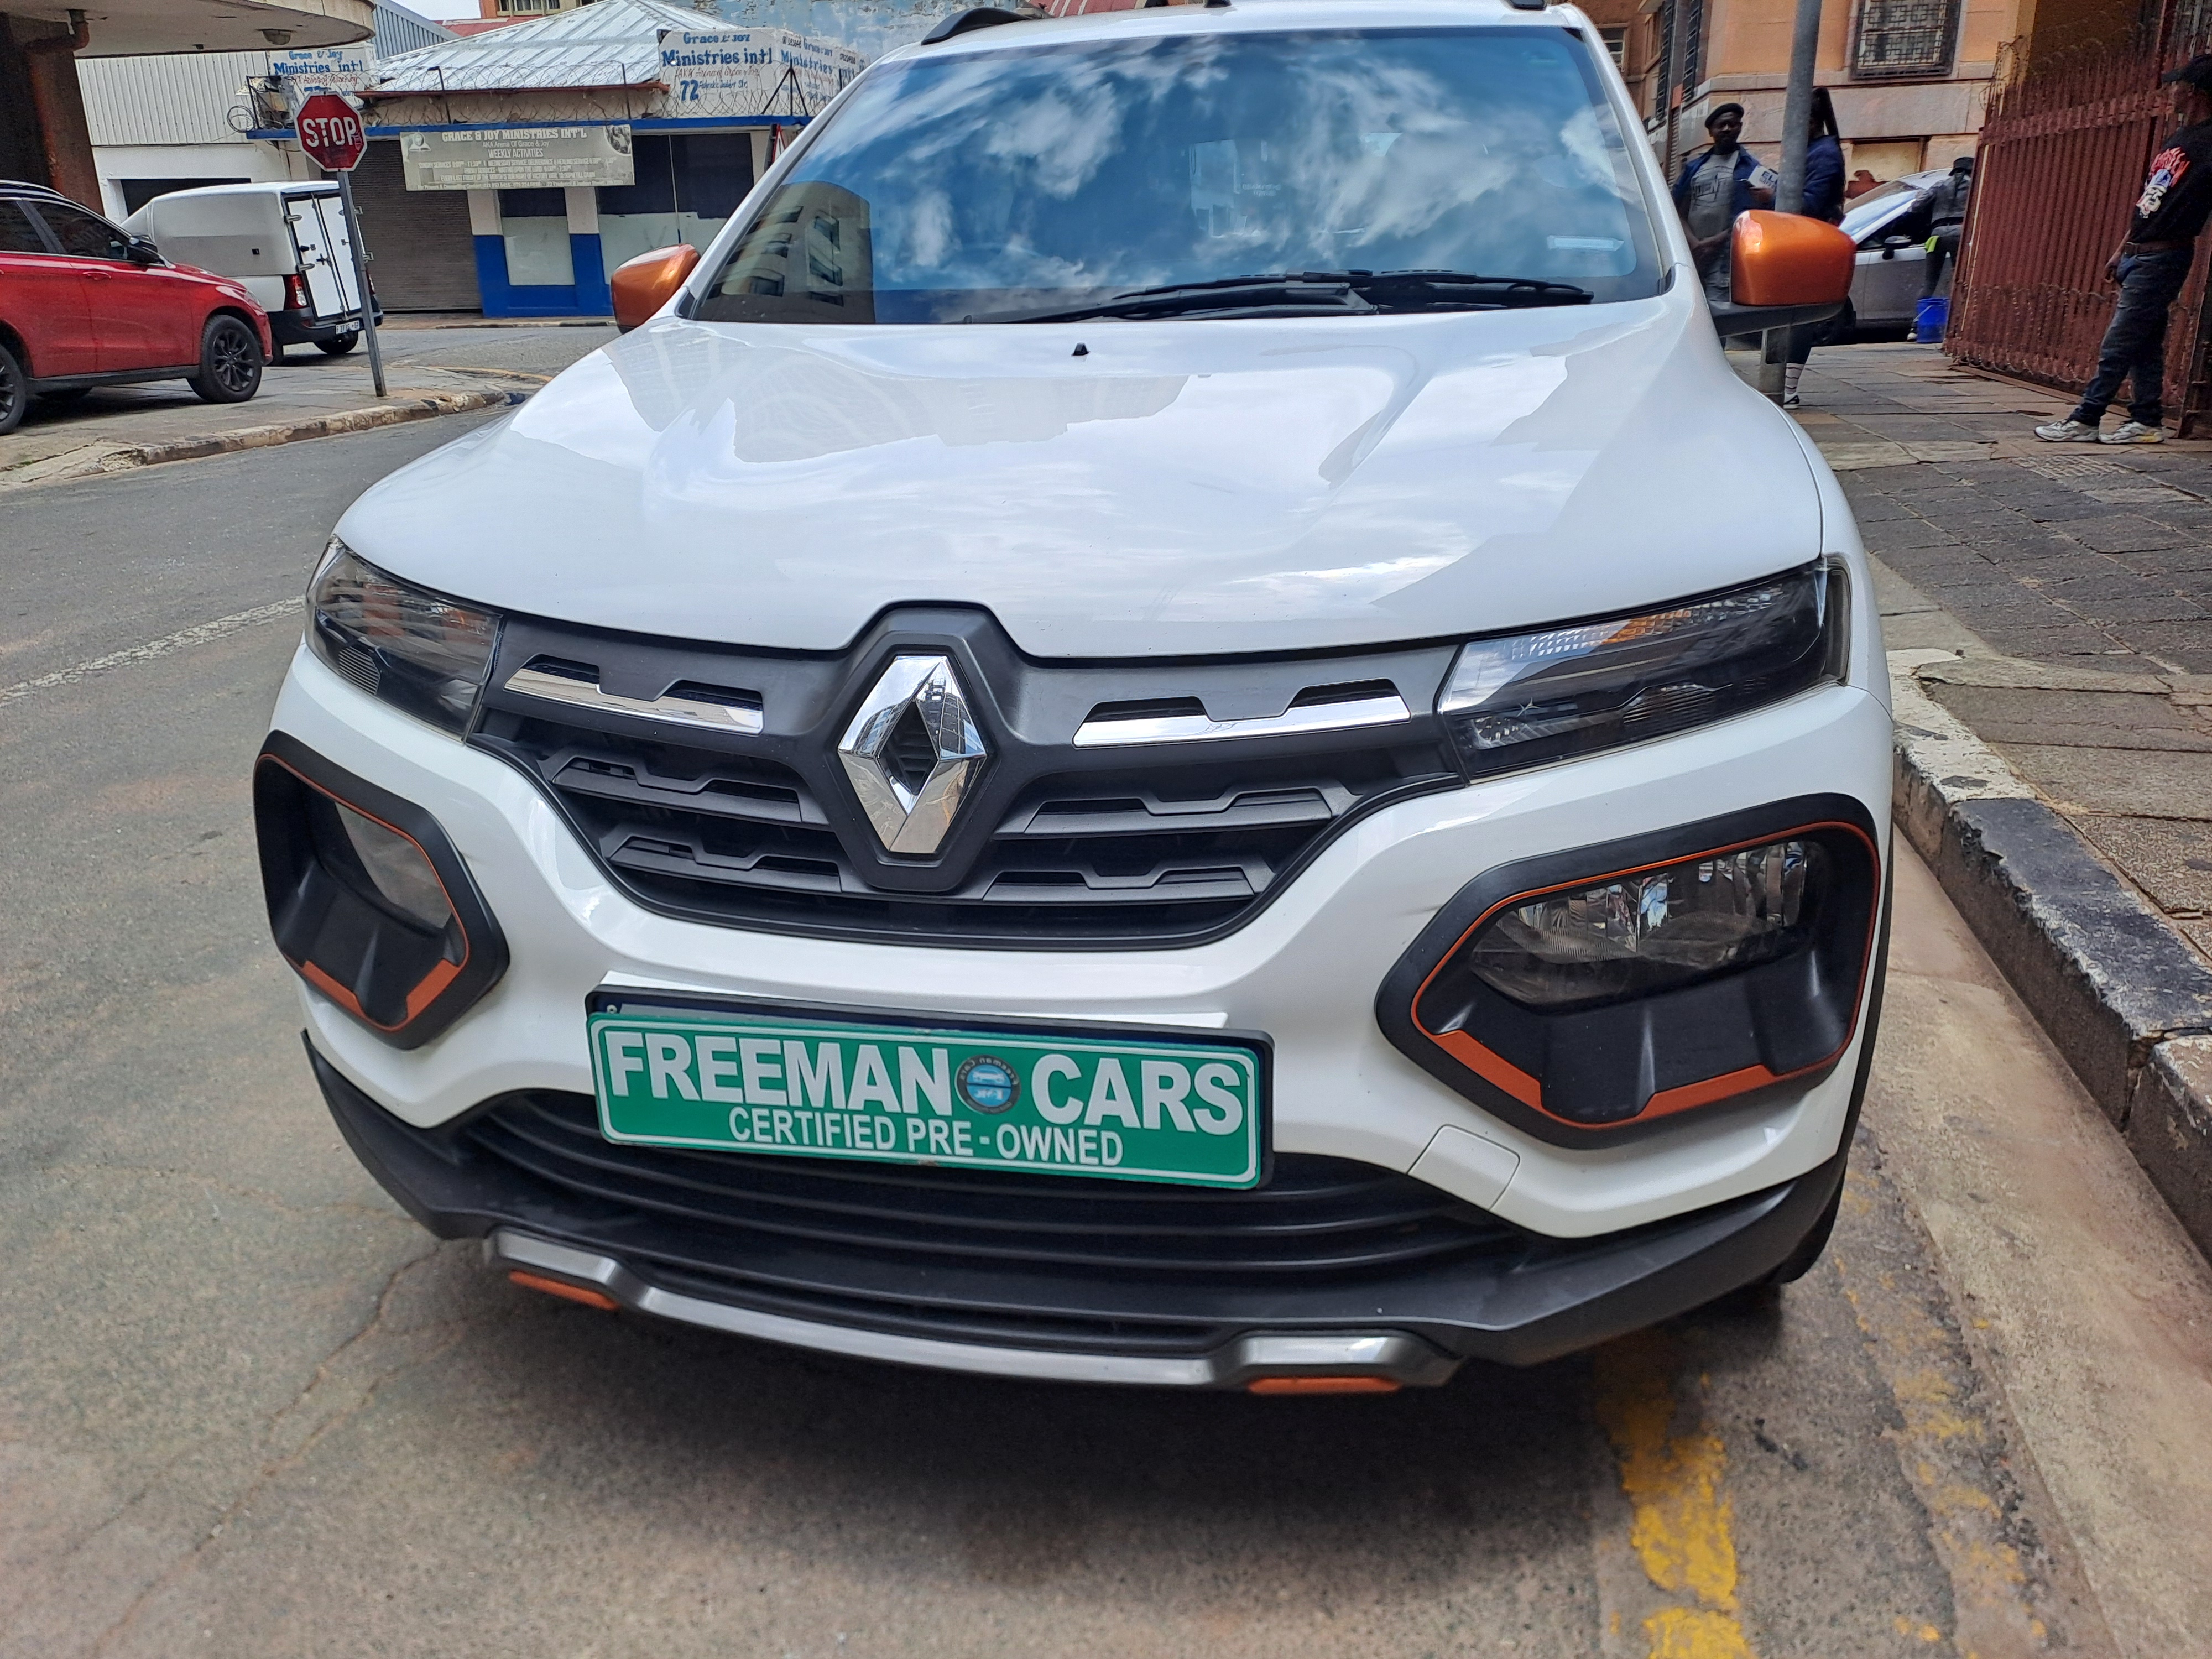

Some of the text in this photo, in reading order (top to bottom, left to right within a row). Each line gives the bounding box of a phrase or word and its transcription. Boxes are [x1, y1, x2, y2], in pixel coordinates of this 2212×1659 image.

[683, 32, 719, 44] Grace
[661, 48, 740, 67] Ministries
[780, 49, 833, 75] Ministries
[273, 61, 331, 75] Ministries
[680, 79, 699, 101] 72
[302, 117, 357, 148] STOP
[442, 131, 473, 142] GRACE
[483, 130, 499, 141] JOY
[502, 128, 559, 140] MINISTRIES
[560, 127, 587, 138] INT'L
[488, 148, 544, 159] WEEKLY ACTIVITIES
[604, 1030, 1243, 1135] FREEMAN CARS
[728, 1107, 896, 1151] CERTIFIED
[906, 1117, 974, 1157] PRE
[996, 1123, 1124, 1167] OWNED
